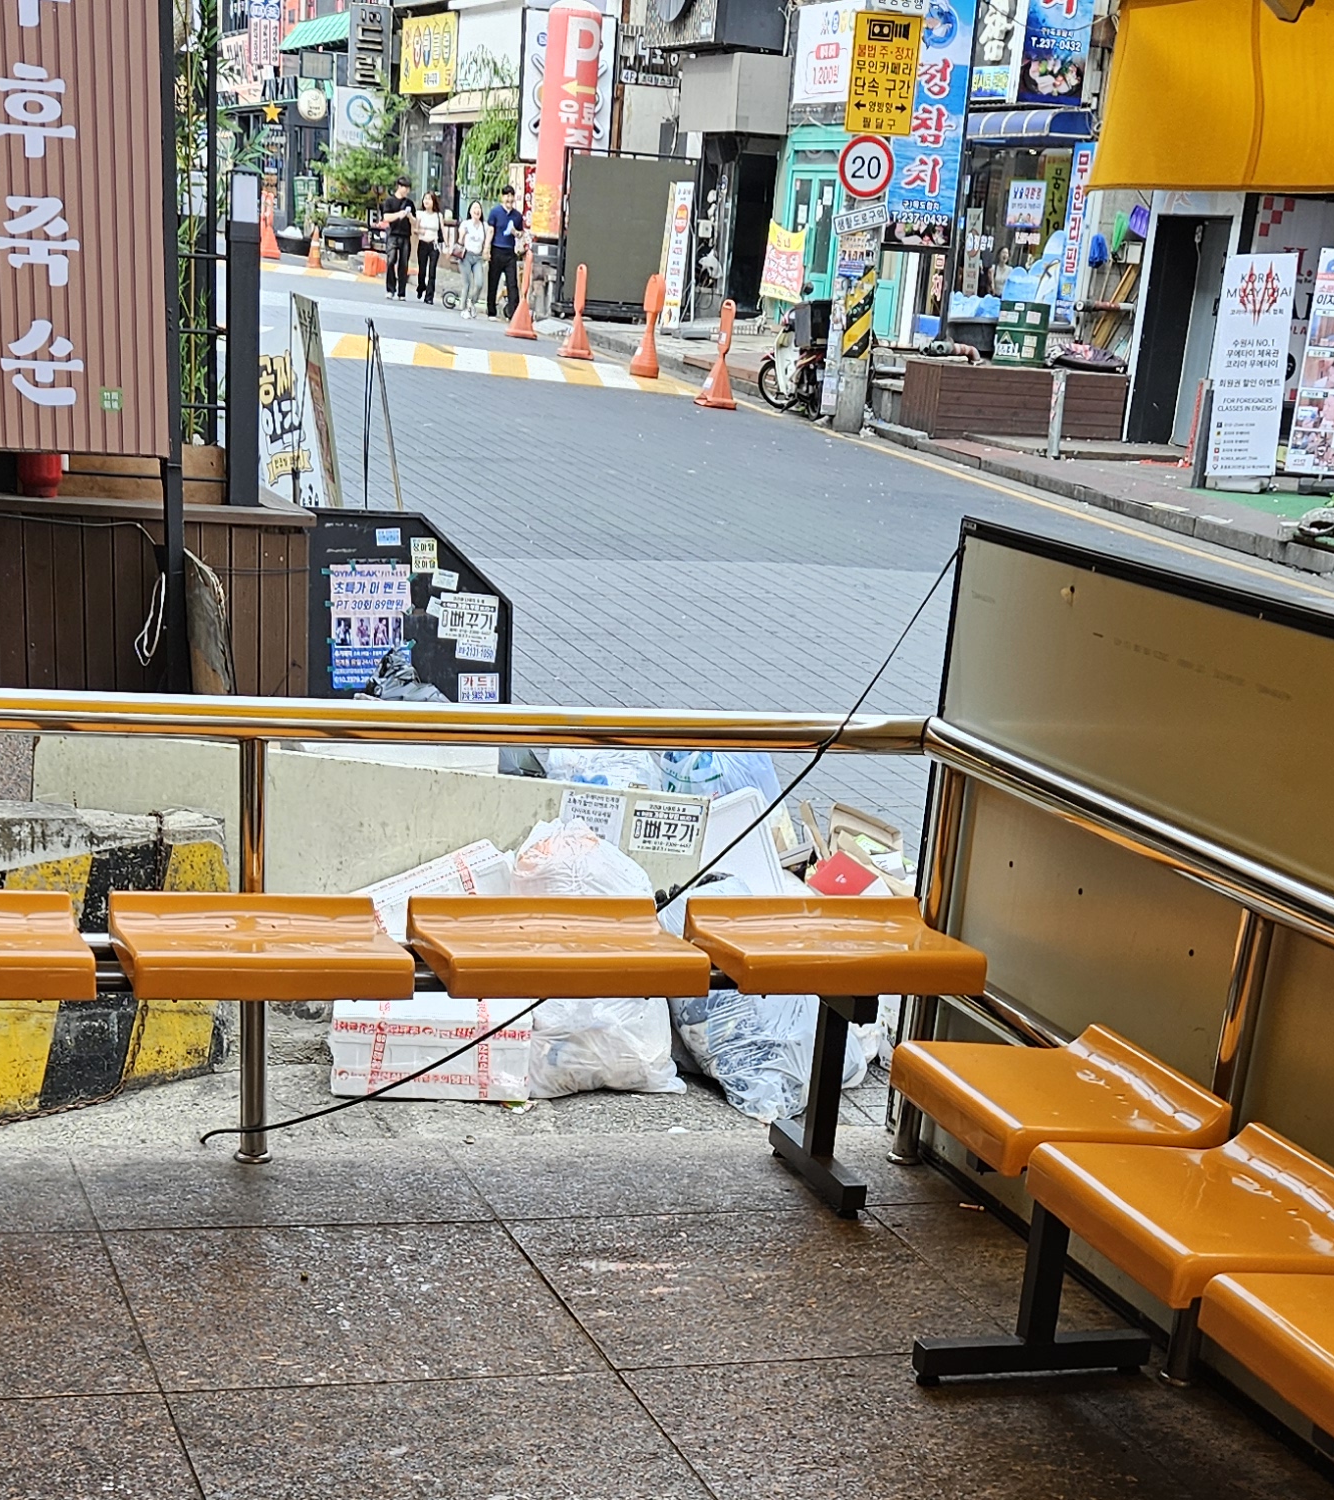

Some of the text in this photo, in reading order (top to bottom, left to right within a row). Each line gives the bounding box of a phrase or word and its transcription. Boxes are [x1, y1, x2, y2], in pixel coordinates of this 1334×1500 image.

[564, 17, 601, 78] P
[857, 44, 876, 58] 불법
[856, 60, 912, 76] 무인카메라
[854, 76, 910, 99] 단속 구간
[851, 155, 882, 180] 20
[837, 209, 885, 231] 생활도로구역
[892, 211, 949, 226] T.237-0432
[1065, 152, 1091, 275] 무한리필
[1240, 272, 1280, 283] KOREA
[1226, 286, 1292, 298] MUAY THAI
[1232, 338, 1255, 347] 수원시
[1226, 350, 1256, 358] 무에타이
[1225, 359, 1279, 368] 코리아 무에타이
[1258, 379, 1281, 387] 이벤트
[333, 581, 366, 595] 초특가
[336, 599, 404, 611] PT 30회 89만원
